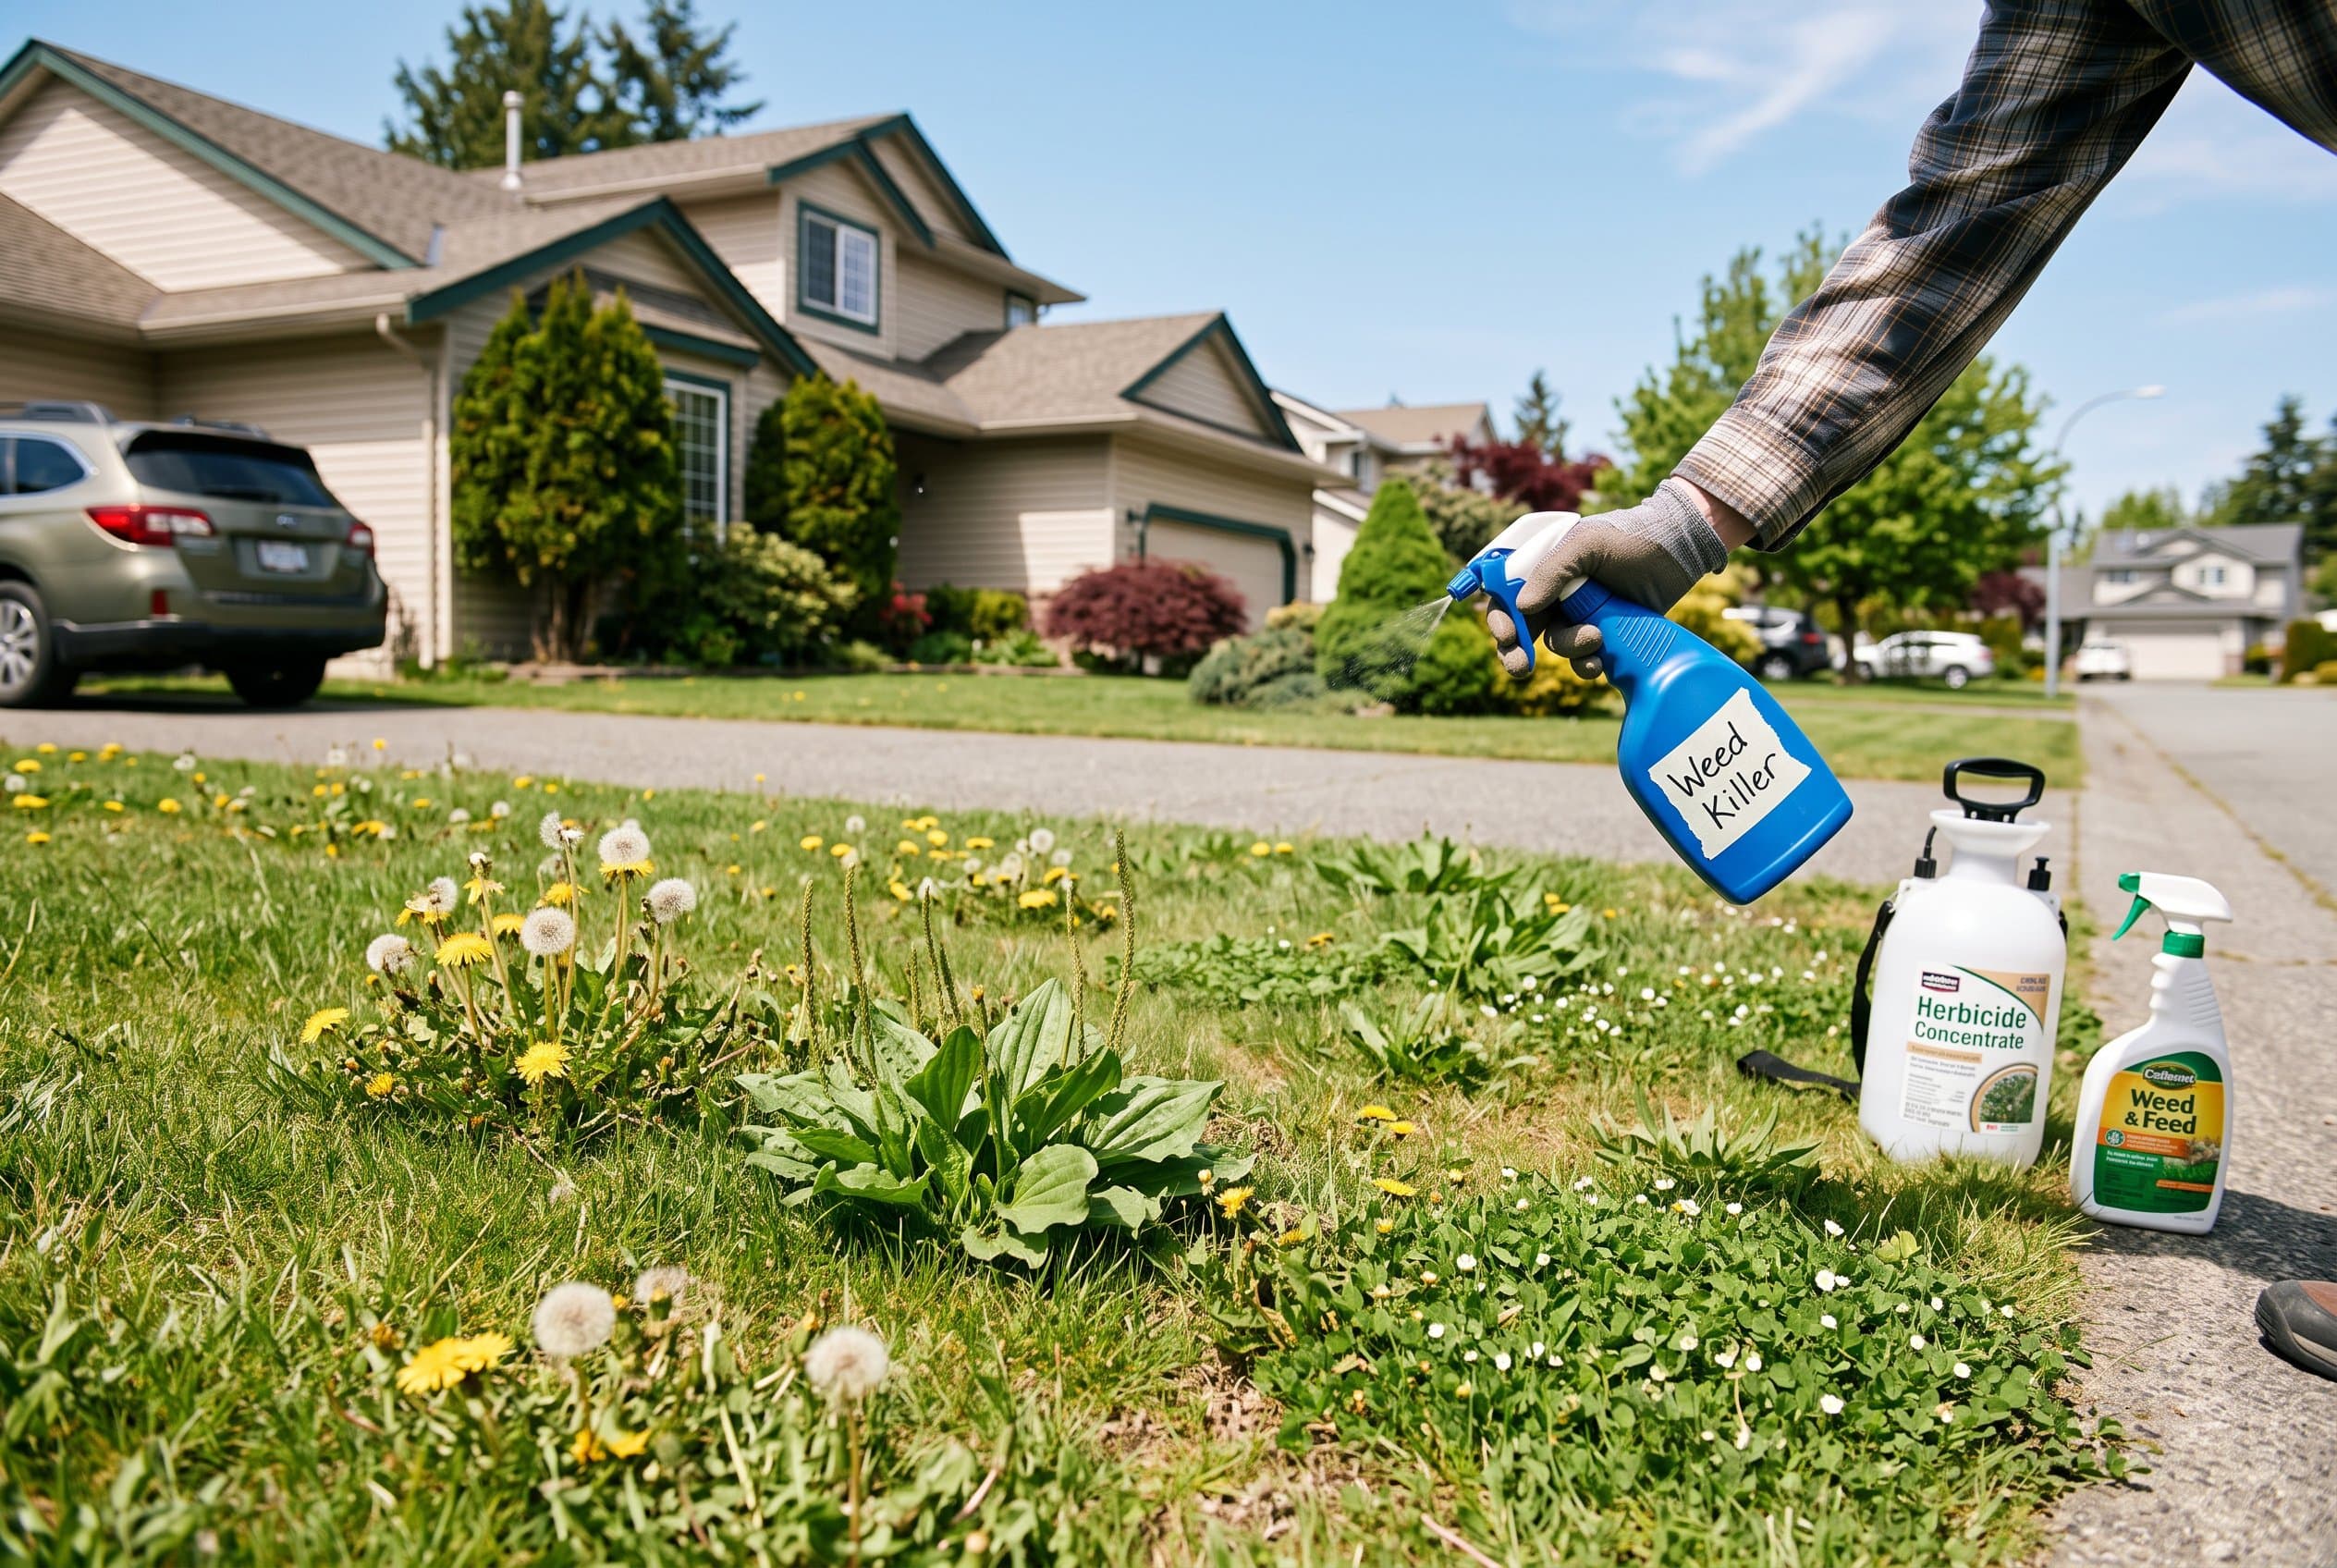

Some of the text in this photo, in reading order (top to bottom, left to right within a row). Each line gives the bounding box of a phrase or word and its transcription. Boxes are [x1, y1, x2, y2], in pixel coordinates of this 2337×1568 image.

[1667, 720, 1747, 797] Weed
[1702, 753, 1776, 829] Killer
[1916, 996, 2026, 1029] Herbicide
[1915, 1021, 2025, 1049] Concentrate
[2131, 1088, 2196, 1114] Weed
[2124, 1110, 2196, 1134] & Feed
